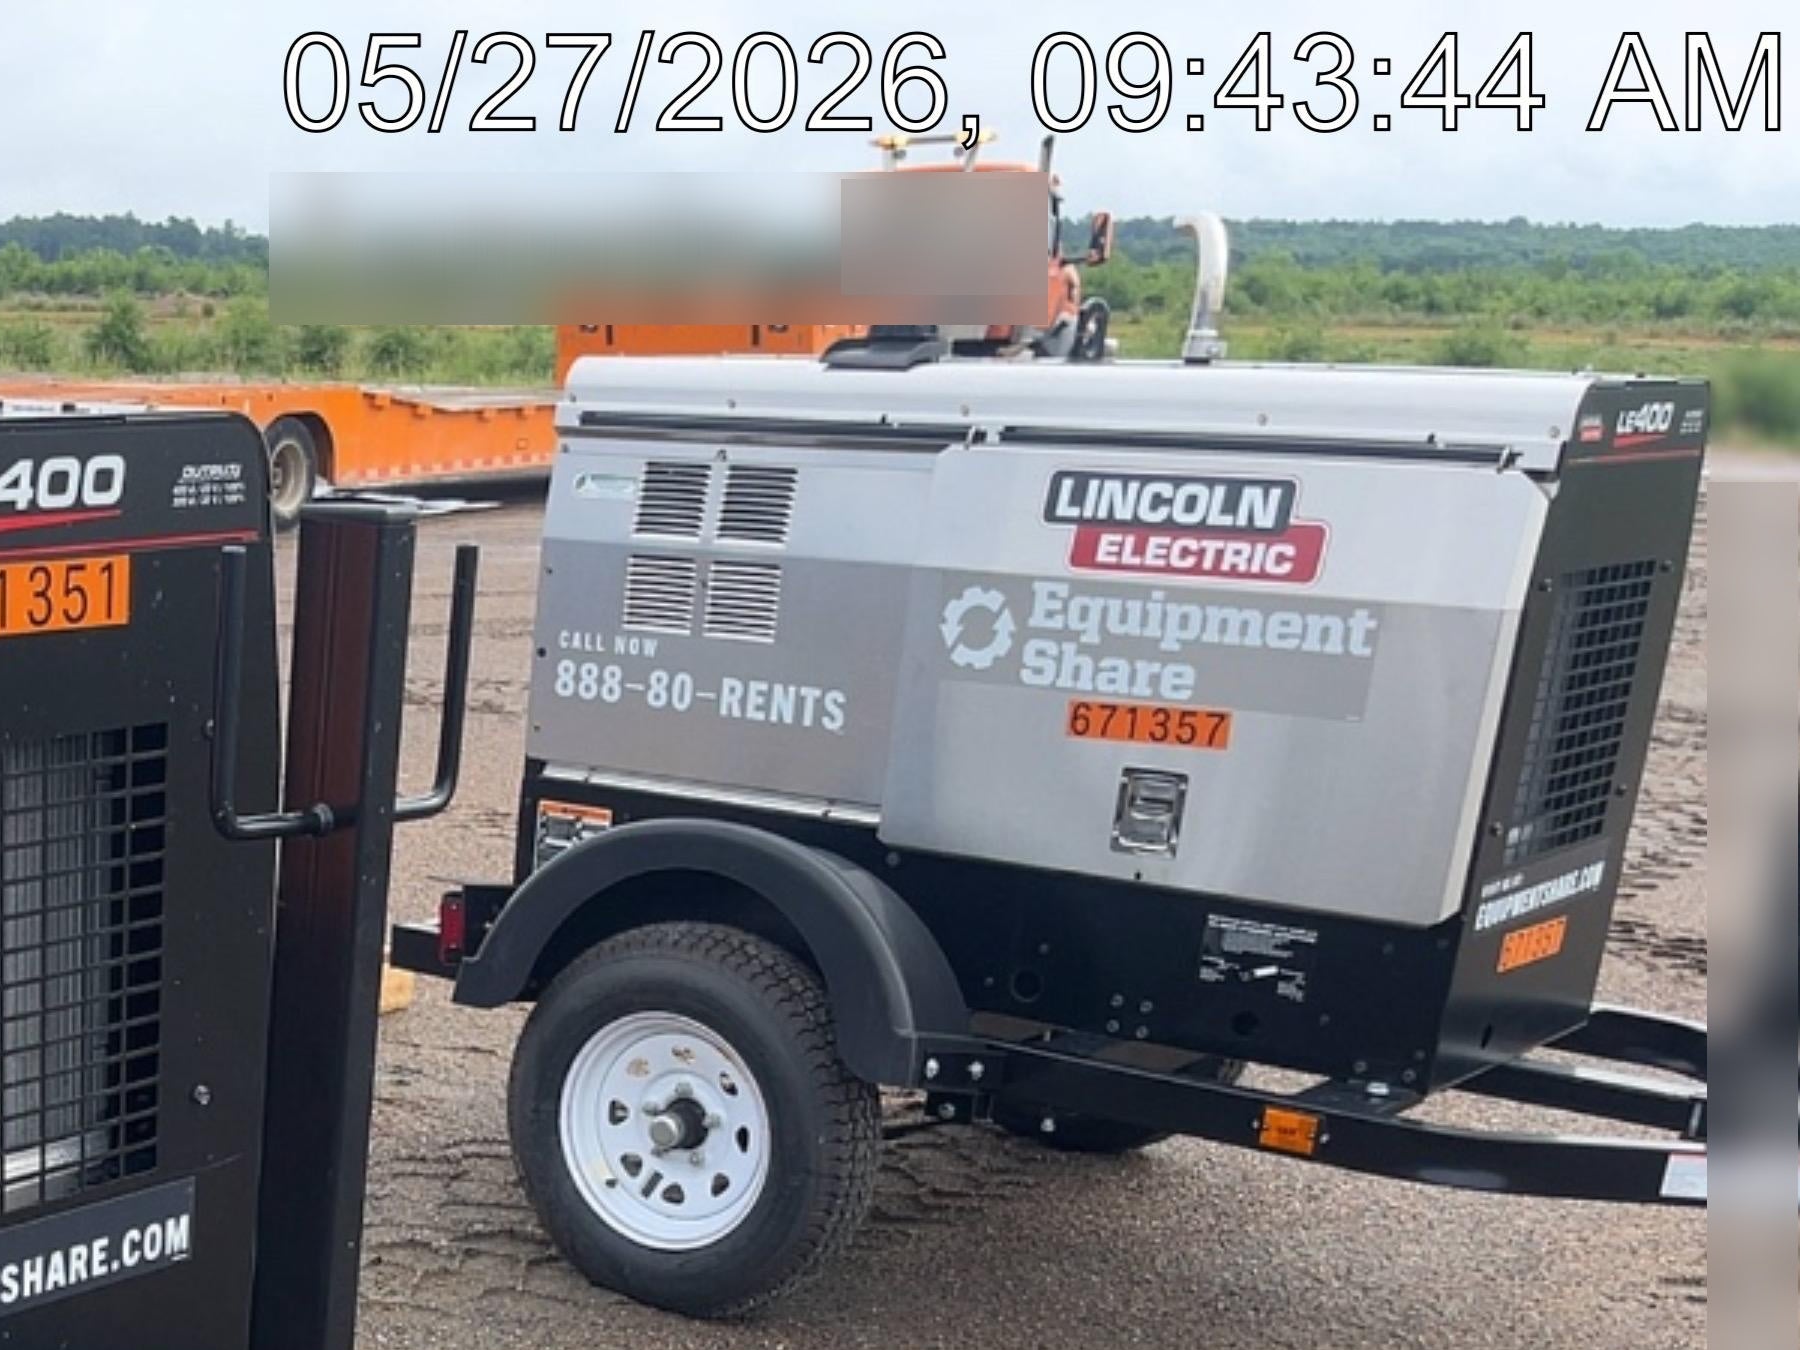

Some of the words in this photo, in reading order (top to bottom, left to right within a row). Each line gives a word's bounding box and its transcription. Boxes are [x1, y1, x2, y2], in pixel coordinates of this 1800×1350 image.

[1616, 401, 1674, 432] LE400
[1055, 477, 1282, 529] LINCOLN
[1095, 533, 1296, 575] ELECTRIC
[1028, 581, 1378, 657] Equipment
[558, 630, 605, 652] CALL
[614, 635, 658, 657] NOW
[1020, 639, 1196, 700] Share
[555, 659, 846, 731] 888-80-RENTS
[1070, 703, 1227, 746] 671357
